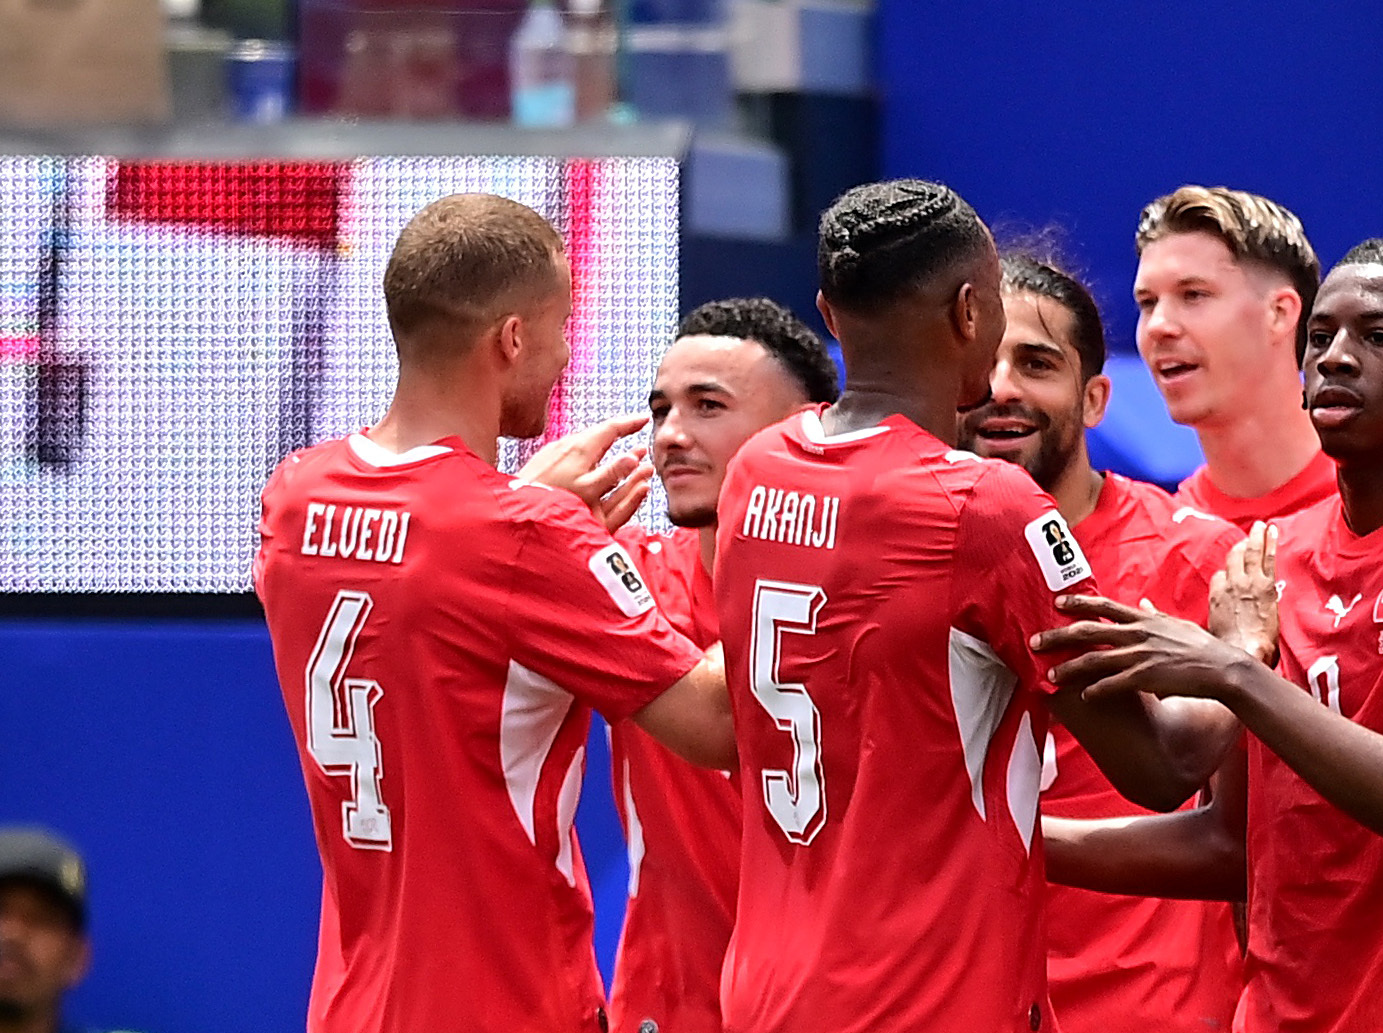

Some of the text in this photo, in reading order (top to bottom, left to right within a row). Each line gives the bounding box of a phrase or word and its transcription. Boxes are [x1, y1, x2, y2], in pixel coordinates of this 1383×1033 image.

[301, 502, 411, 564] ELVEDI
[743, 485, 840, 549] AKANJI
[305, 588, 391, 852] 4
[750, 579, 828, 846] 5
